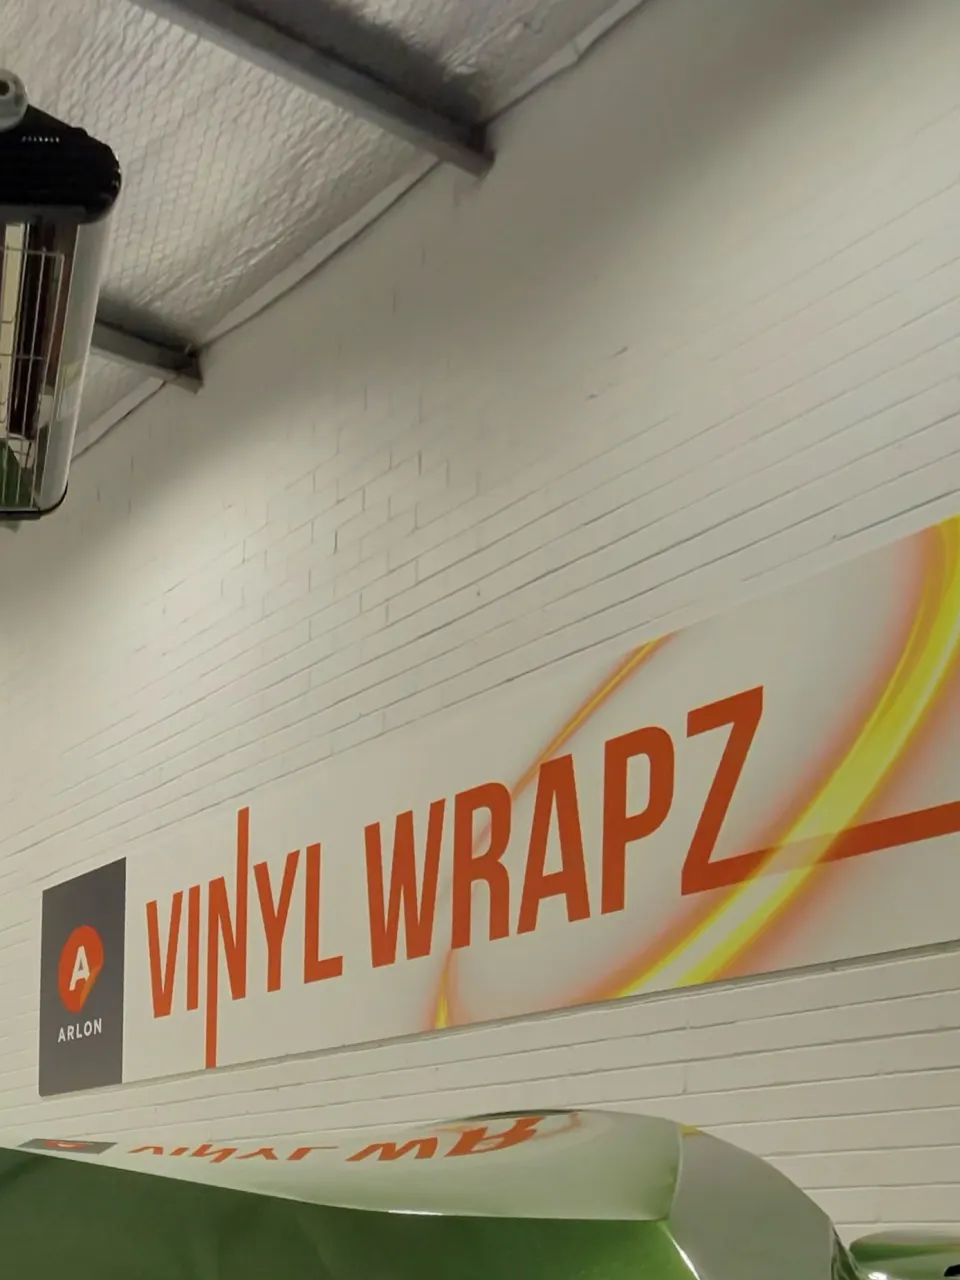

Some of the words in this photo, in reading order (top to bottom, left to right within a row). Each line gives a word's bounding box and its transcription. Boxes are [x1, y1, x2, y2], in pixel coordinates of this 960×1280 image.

[145, 806, 344, 1069] VINYL
[364, 685, 778, 968] WRAPZ
[57, 1018, 103, 1043] ARLON
